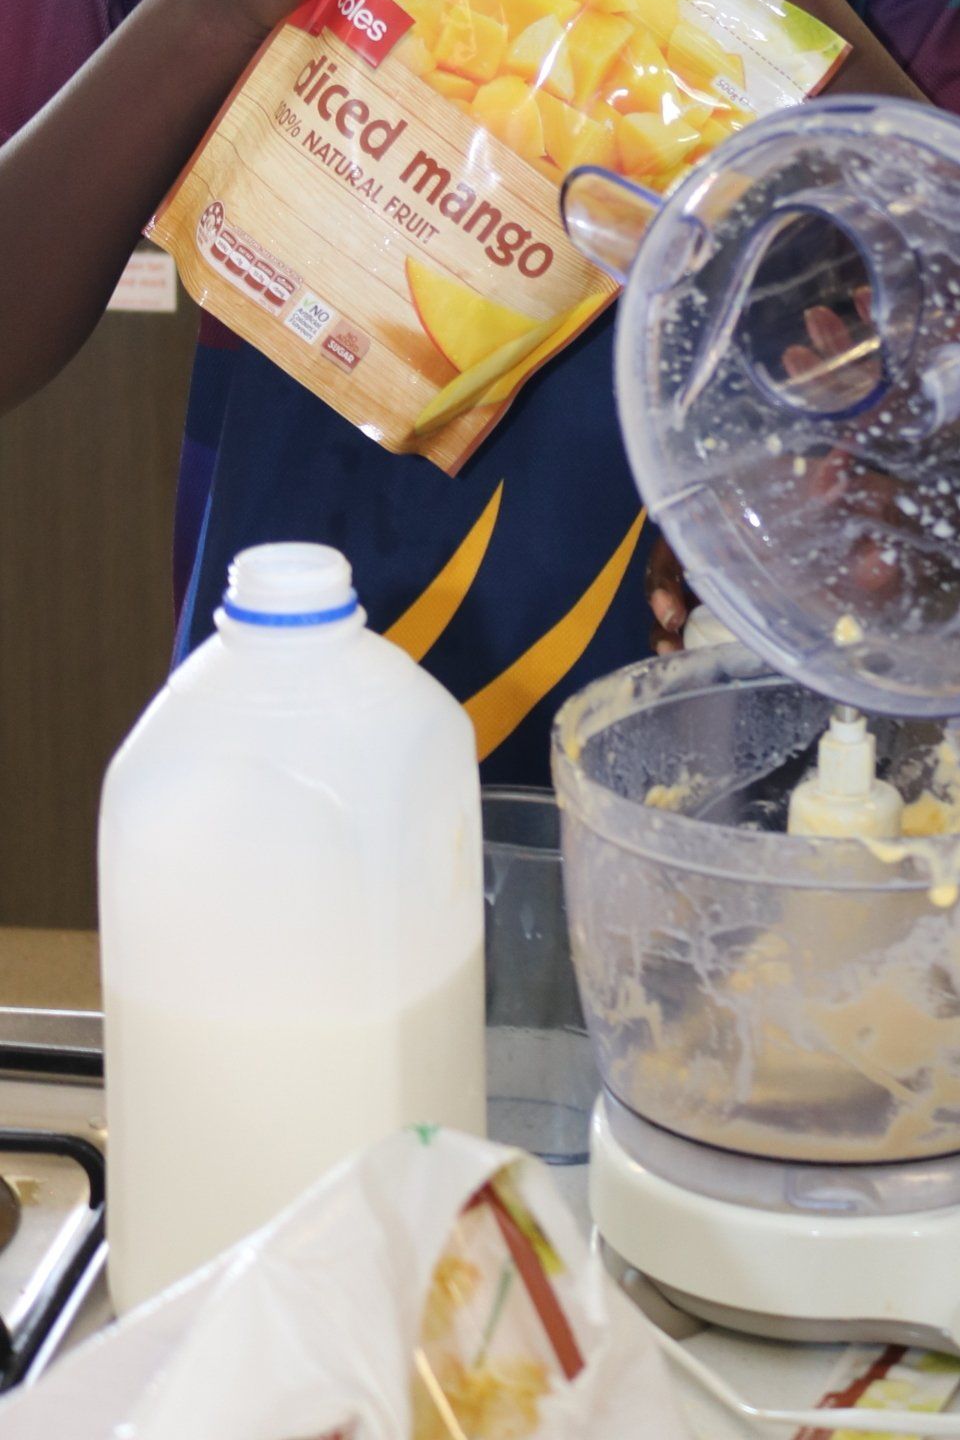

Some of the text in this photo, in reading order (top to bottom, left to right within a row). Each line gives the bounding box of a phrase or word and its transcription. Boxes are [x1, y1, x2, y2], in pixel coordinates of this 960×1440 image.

[293, 55, 409, 162] diced
[399, 150, 554, 279] mango
[301, 129, 386, 204] NATURAL
[383, 195, 441, 246] FRUIT
[308, 304, 330, 323] NO
[327, 339, 355, 364] SUGAR
